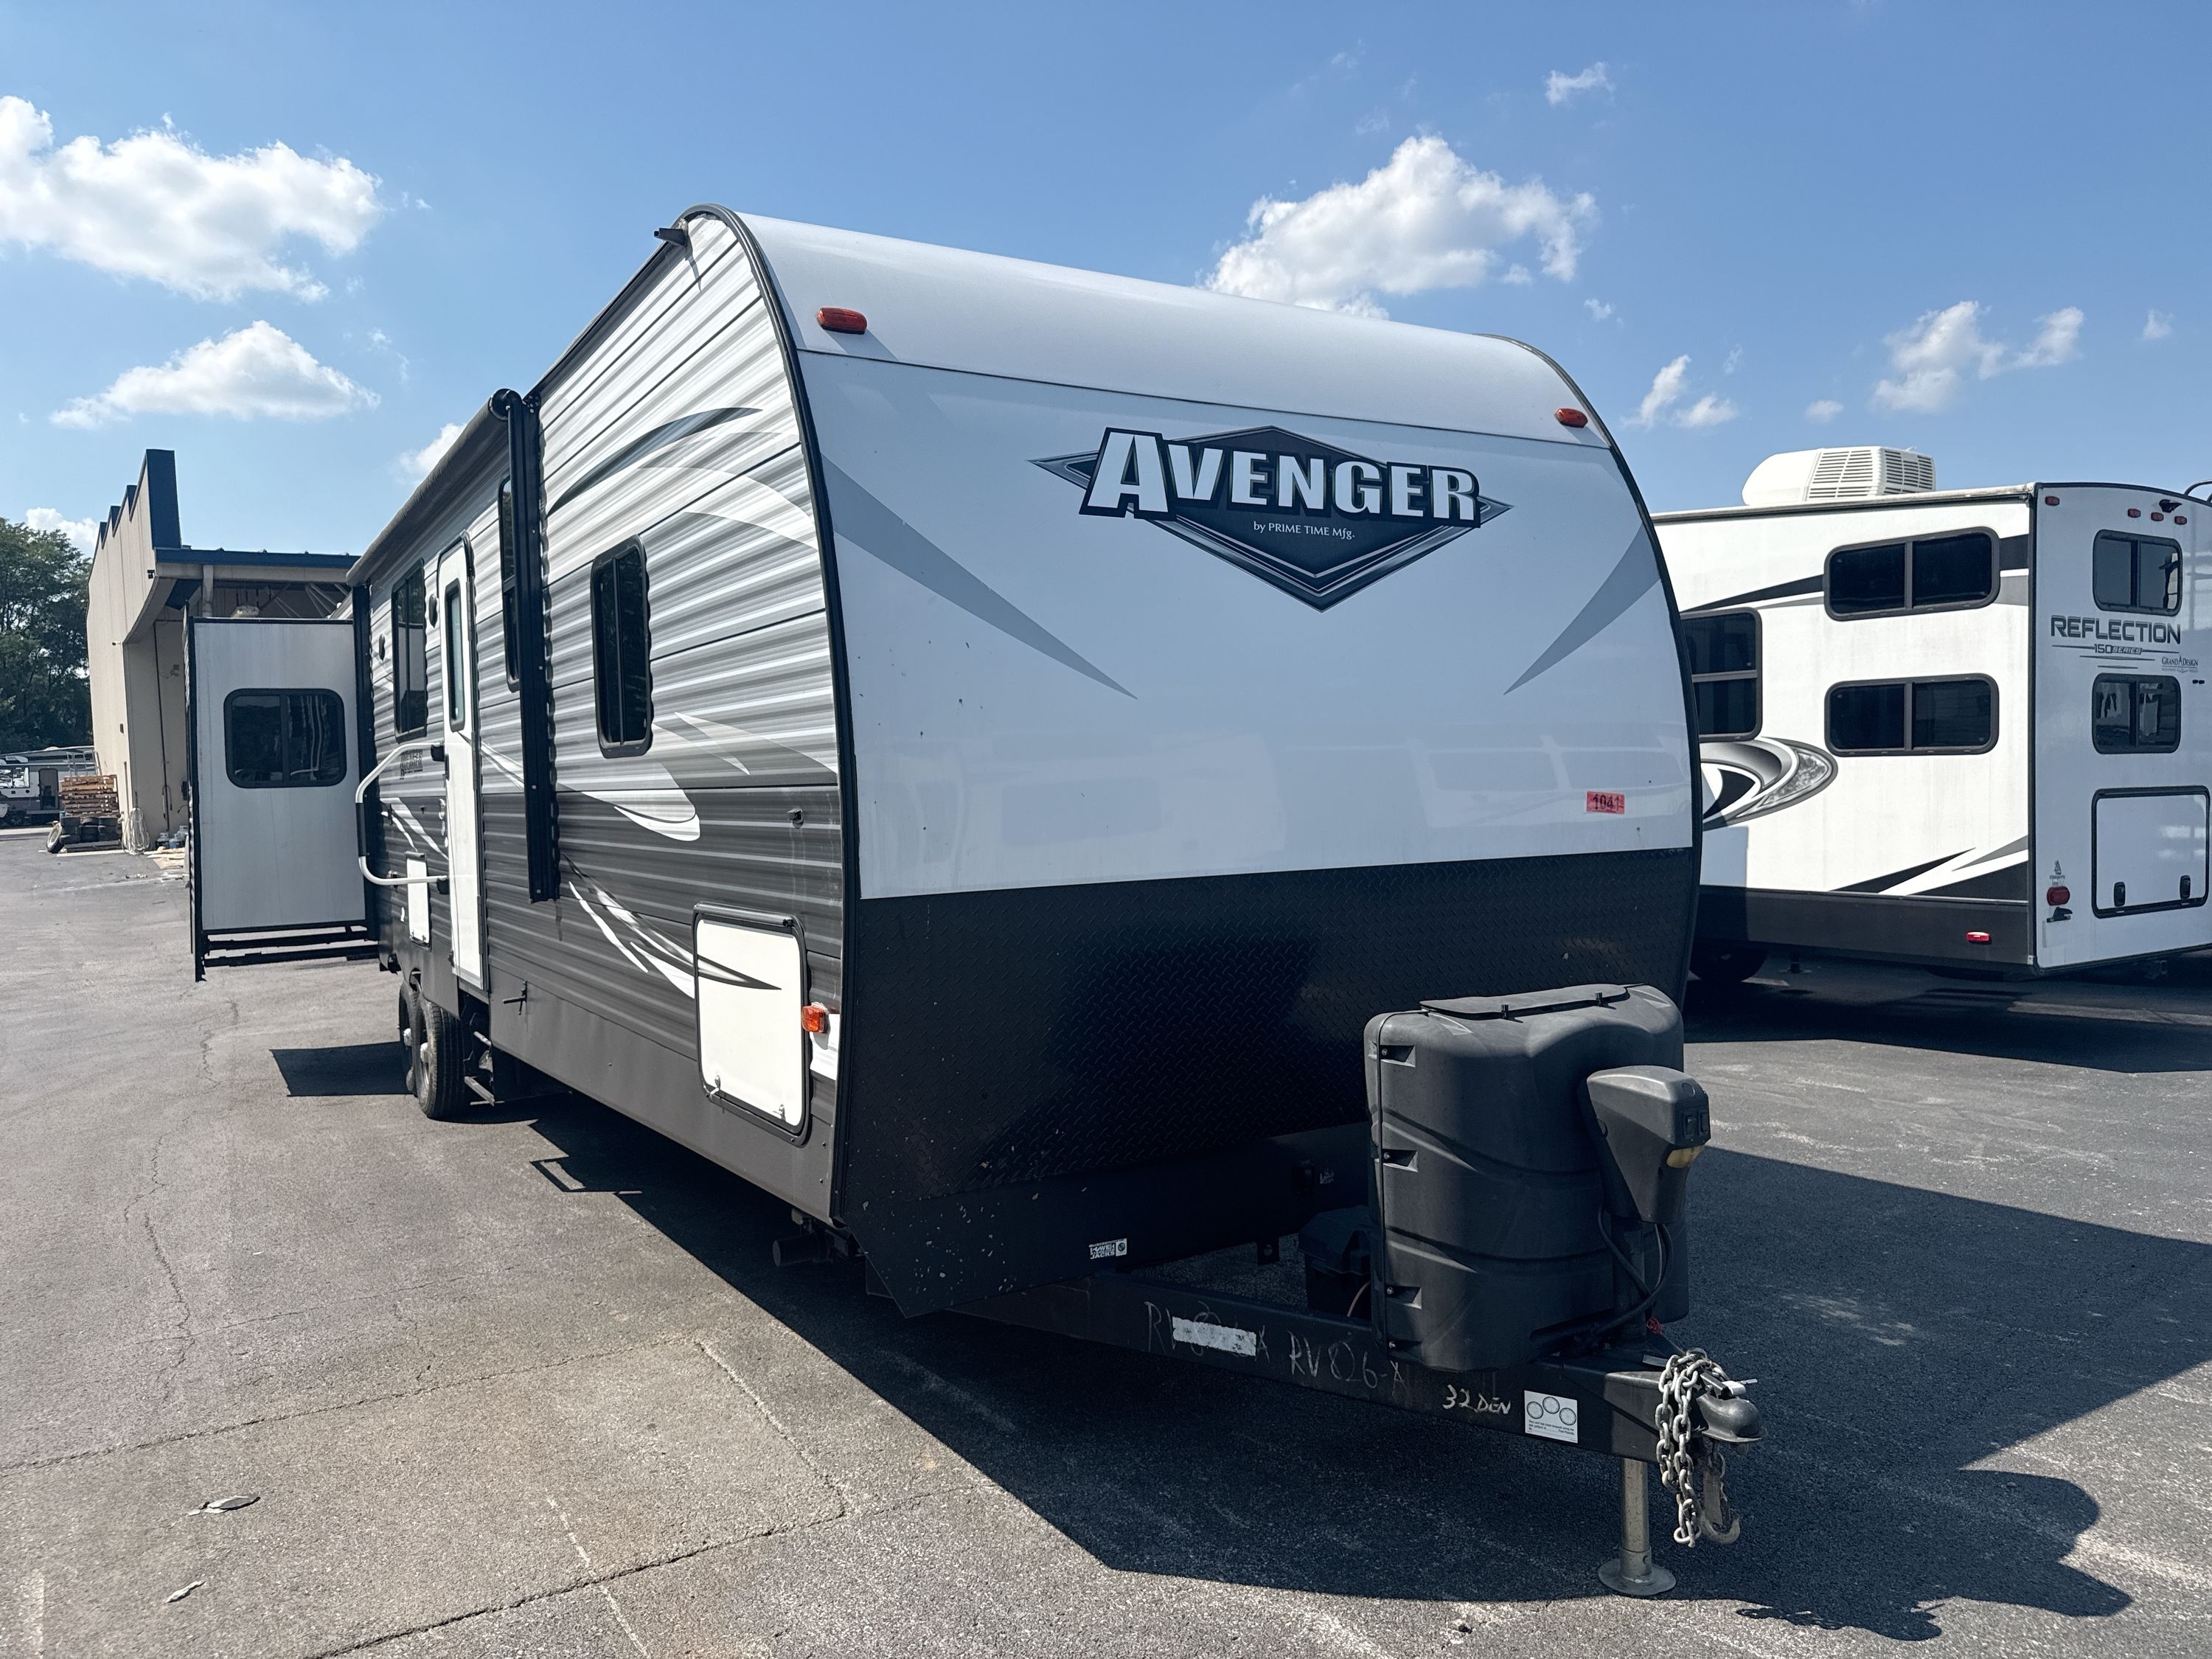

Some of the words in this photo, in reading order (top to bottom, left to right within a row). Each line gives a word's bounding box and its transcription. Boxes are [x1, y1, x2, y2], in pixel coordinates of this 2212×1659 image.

[1080, 428, 1481, 527] AVENGER
[1253, 521, 1266, 533] by
[1268, 523, 1301, 534] PRIME
[1304, 525, 1329, 536] TIME
[1332, 527, 1355, 540] Mfg.
[2051, 615, 2181, 644] REFLECTION
[2094, 644, 2112, 653] 150
[2111, 646, 2143, 655] SERIES
[1090, 1251, 1115, 1259] JACKS
